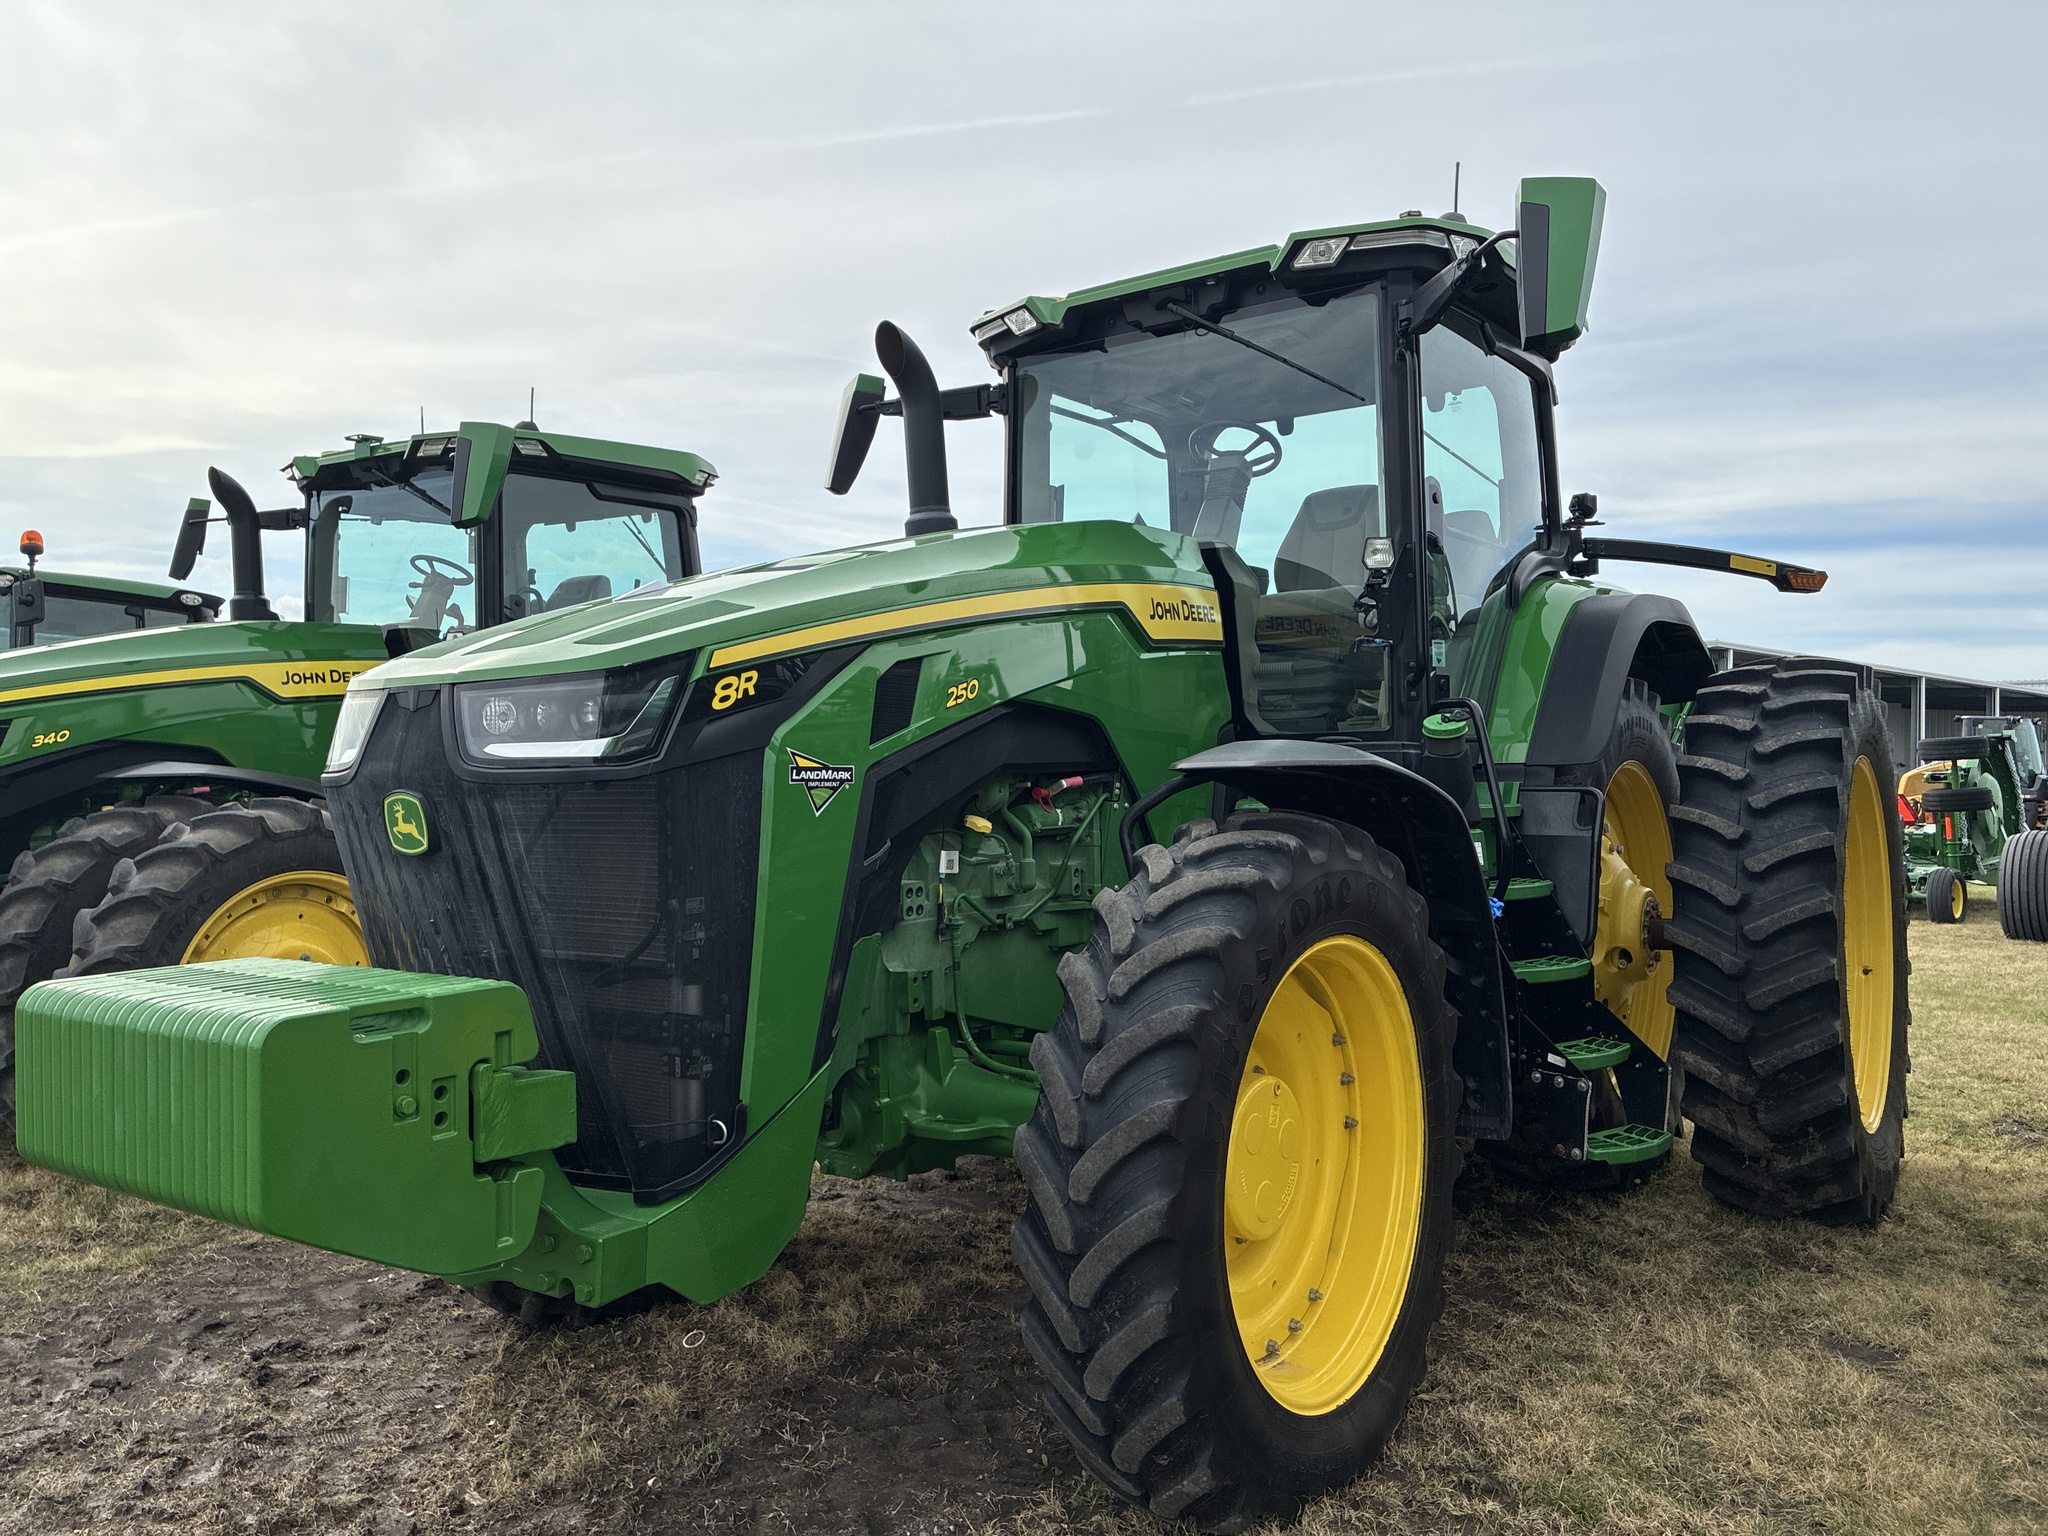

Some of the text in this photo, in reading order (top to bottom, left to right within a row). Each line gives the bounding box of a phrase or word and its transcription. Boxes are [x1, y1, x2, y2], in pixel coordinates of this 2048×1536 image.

[1149, 597, 1217, 624] JOHN DEERE
[281, 669, 364, 686] JOHN DE
[711, 670, 759, 711] 8R
[946, 678, 980, 708] 250
[31, 729, 71, 748] 340
